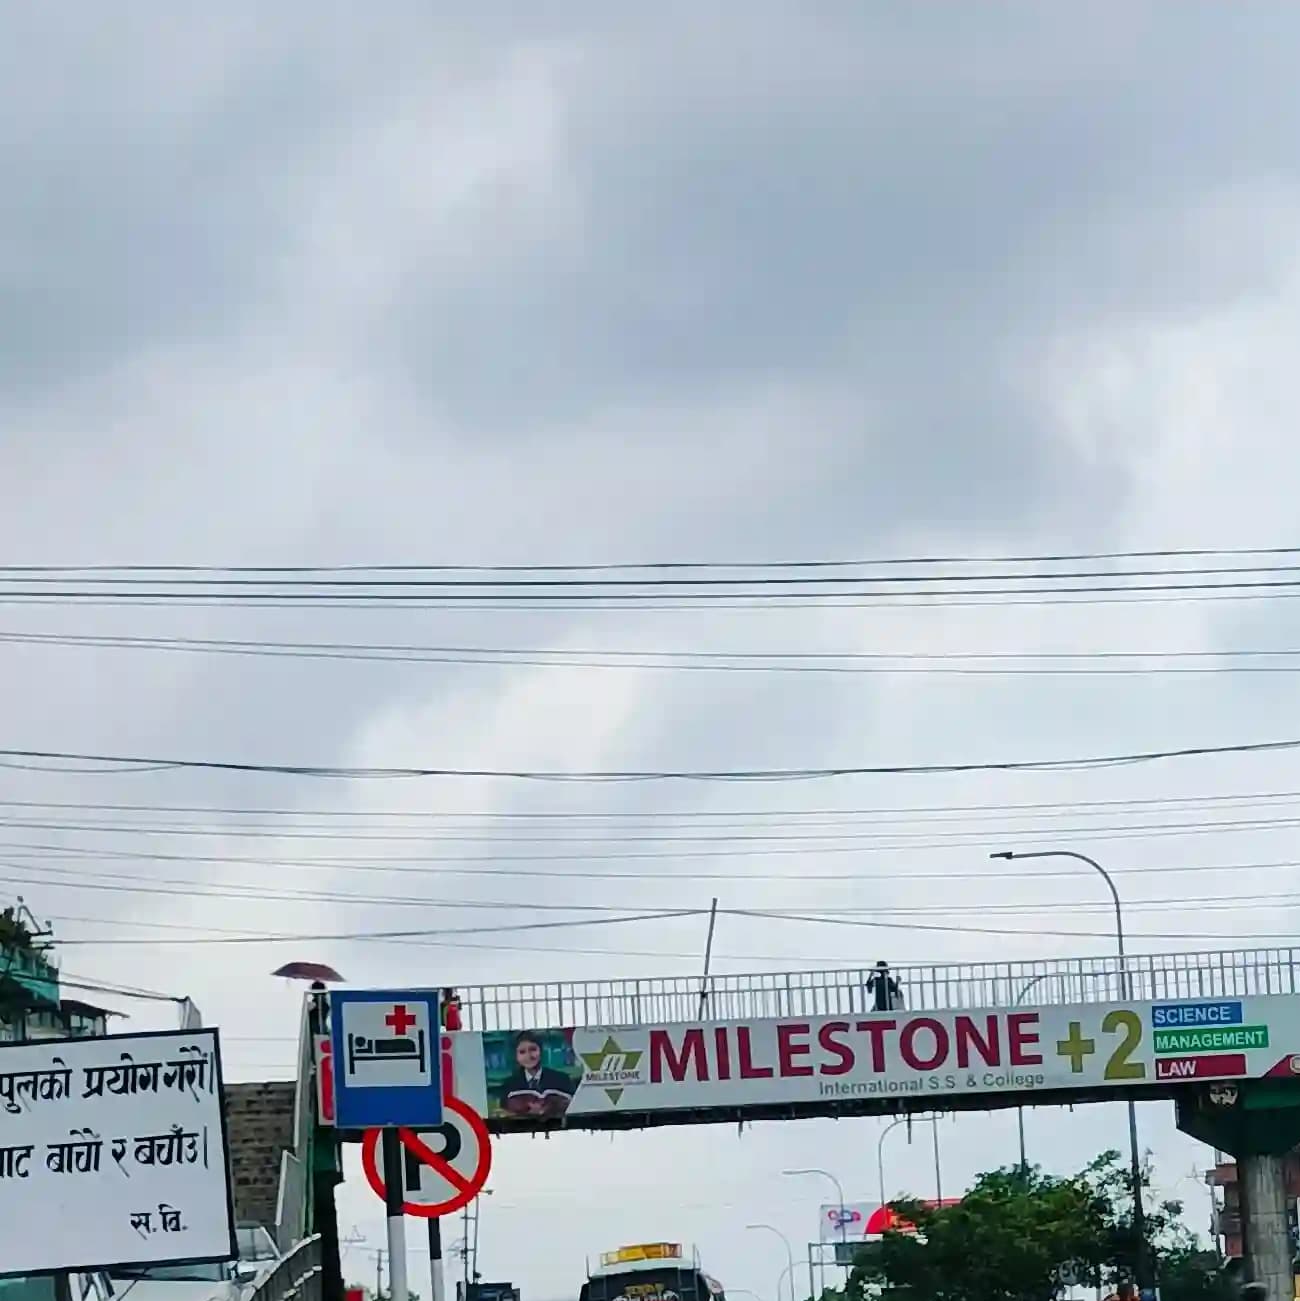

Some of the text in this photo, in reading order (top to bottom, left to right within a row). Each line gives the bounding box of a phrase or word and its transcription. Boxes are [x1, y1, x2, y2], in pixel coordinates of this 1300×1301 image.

[1154, 1005, 1232, 1025] SCIENCE
[649, 1009, 1146, 1084] MILESTONE +2
[1156, 1030, 1265, 1050] MANAGEMENT
[82, 1053, 162, 1099] प्रयोग
[1158, 1060, 1197, 1078] LAW
[819, 1077, 923, 1096] International
[966, 1073, 977, 1088] &
[983, 1070, 1044, 1088] College
[111, 1138, 130, 1178] र
